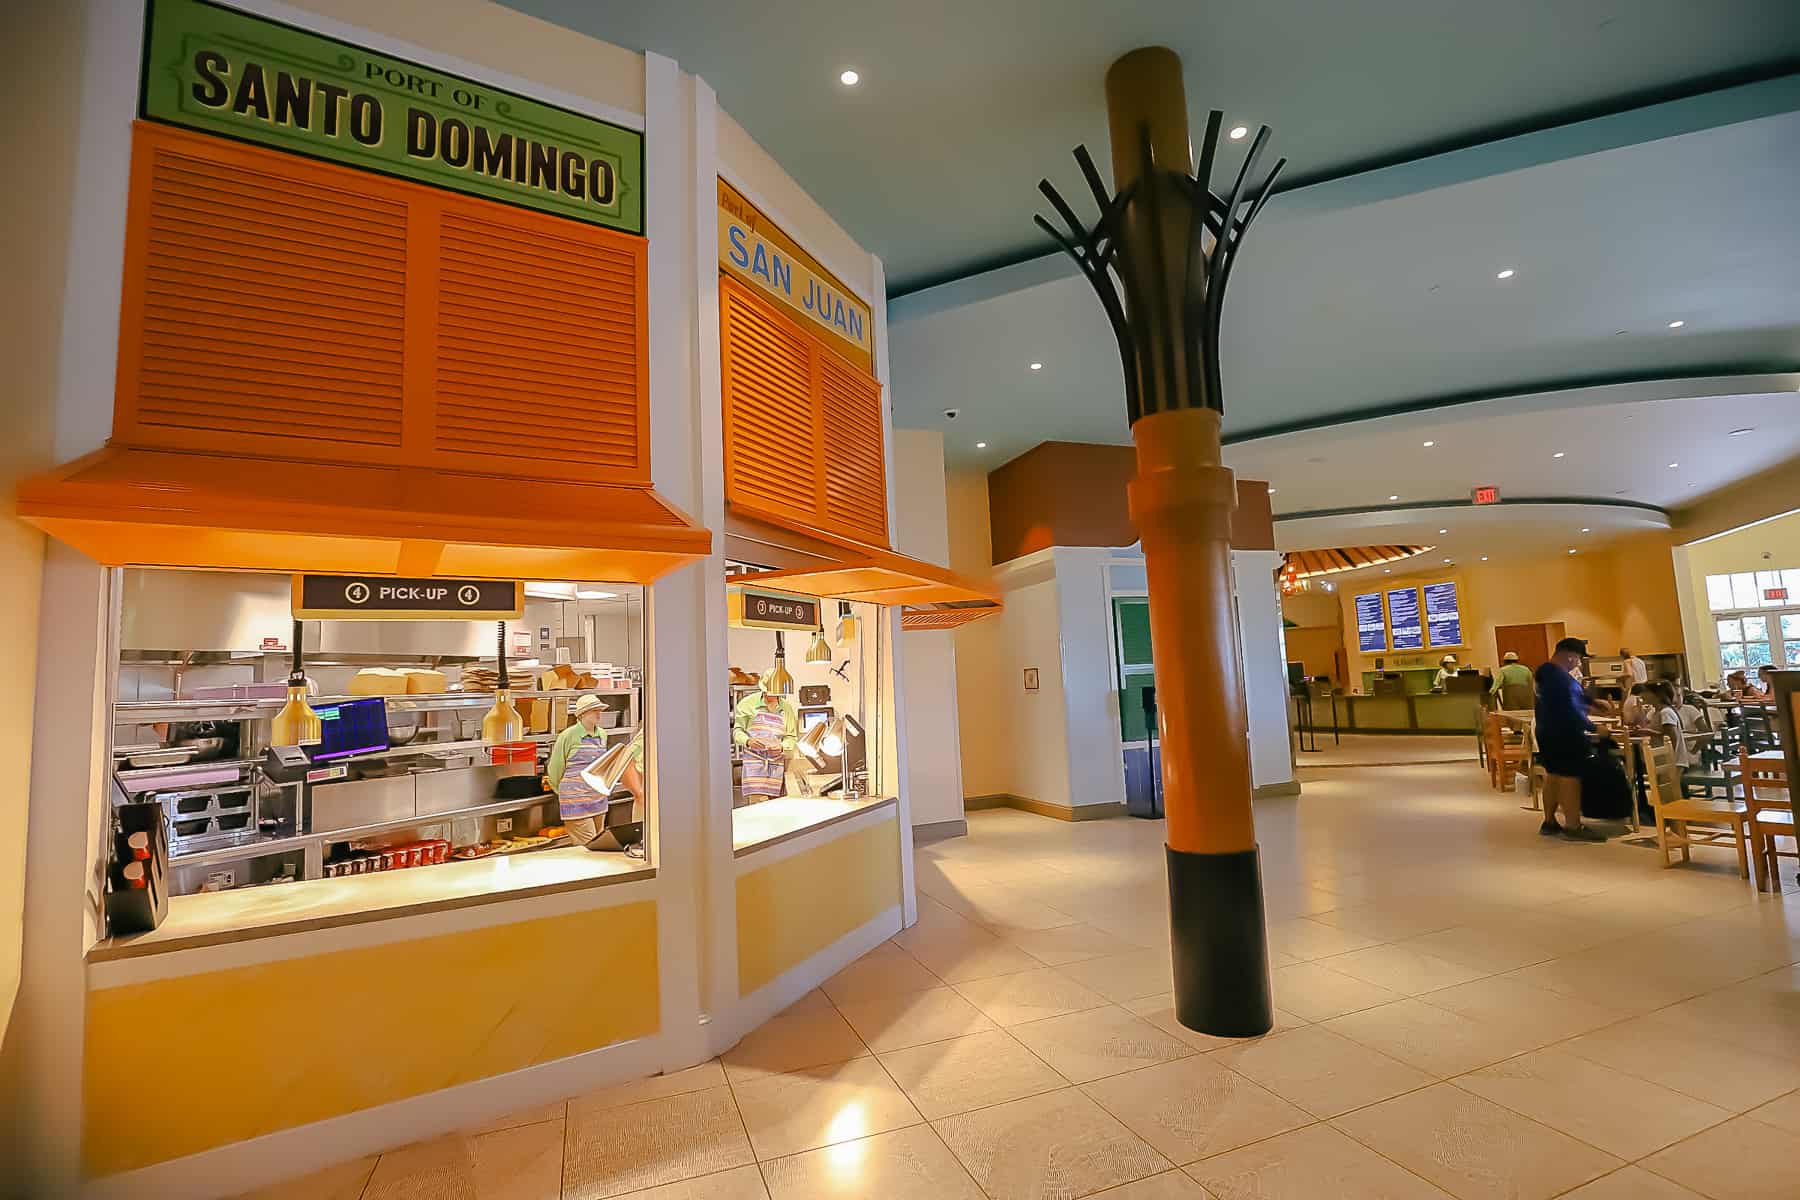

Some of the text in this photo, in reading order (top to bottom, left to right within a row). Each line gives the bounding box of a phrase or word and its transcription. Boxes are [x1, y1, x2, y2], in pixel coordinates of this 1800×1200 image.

[365, 61, 488, 110] PORT OF
[191, 50, 617, 207] SANTO DOMINGO
[728, 225, 863, 341] SAN JUAN
[1477, 490, 1495, 503] EXIT
[379, 586, 448, 600] PICK-UP
[768, 603, 793, 614] PICK-UP
